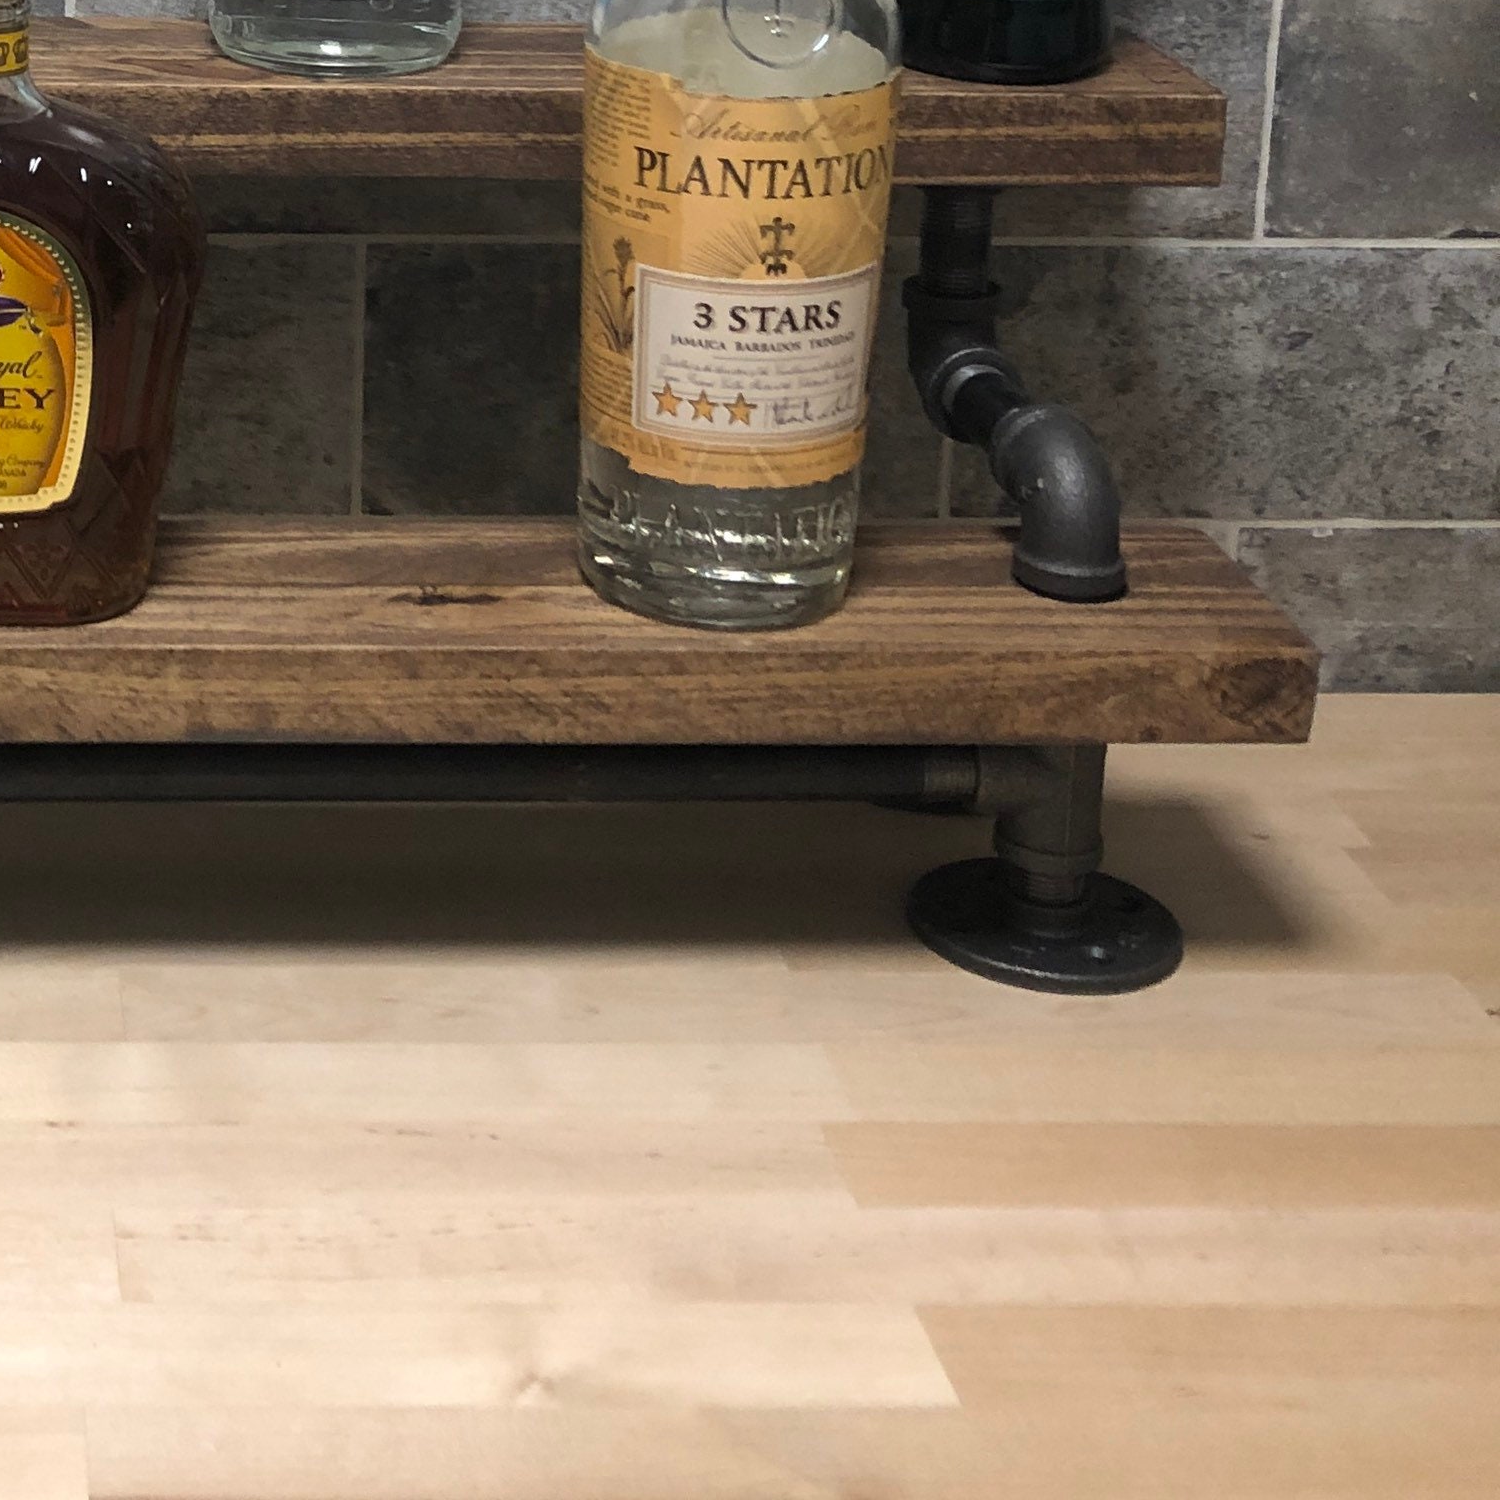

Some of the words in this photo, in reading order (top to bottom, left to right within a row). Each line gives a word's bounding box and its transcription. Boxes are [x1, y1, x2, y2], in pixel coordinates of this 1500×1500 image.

[693, 302, 713, 330] 3
[728, 300, 843, 334] STARS
[670, 334, 726, 351] JAMAICA
